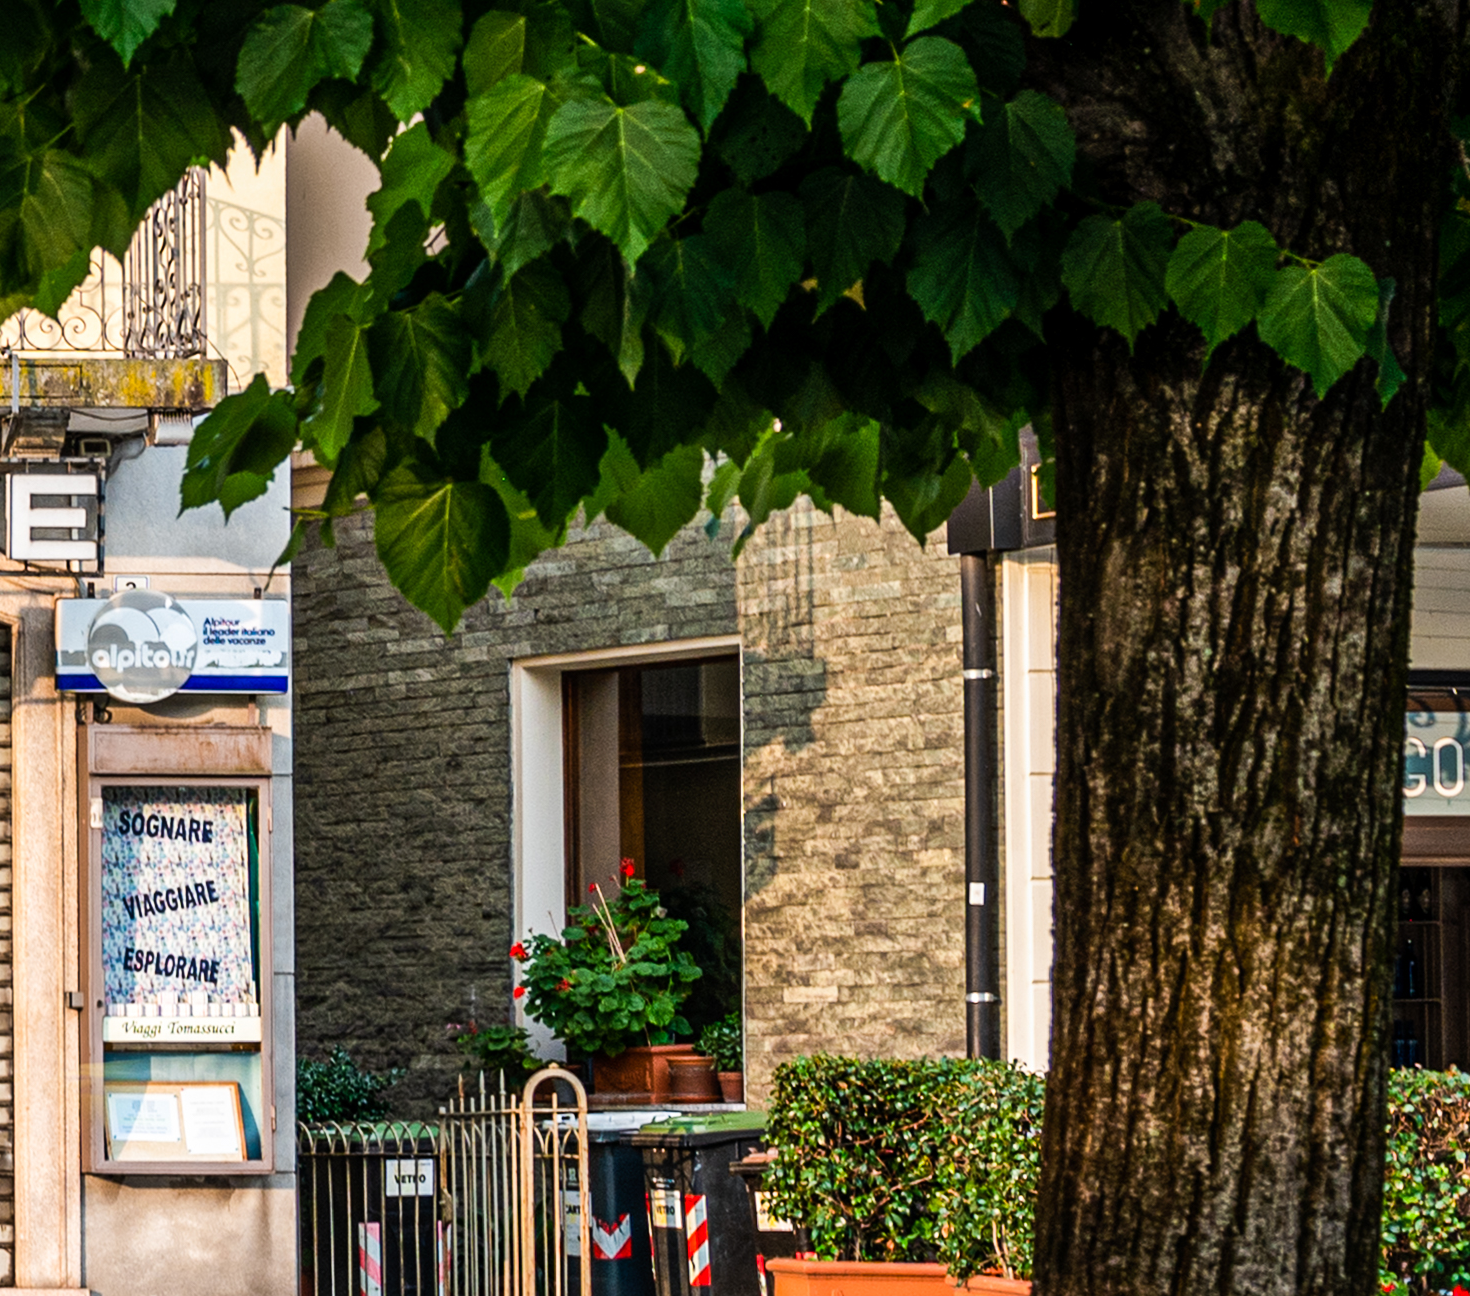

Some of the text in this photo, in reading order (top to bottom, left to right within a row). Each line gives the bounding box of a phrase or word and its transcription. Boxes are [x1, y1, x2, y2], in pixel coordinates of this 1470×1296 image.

[203, 617, 240, 628] Alpitour
[210, 626, 239, 636] leader
[241, 627, 276, 637] italiano
[203, 636, 266, 645] delle vacanze
[92, 643, 195, 674] alpitour
[118, 810, 214, 843] SOGNARE
[123, 880, 219, 920] VIAGGIARE
[123, 947, 220, 984] ESPLORARE
[122, 1021, 236, 1038] Viaggi Tomassucci
